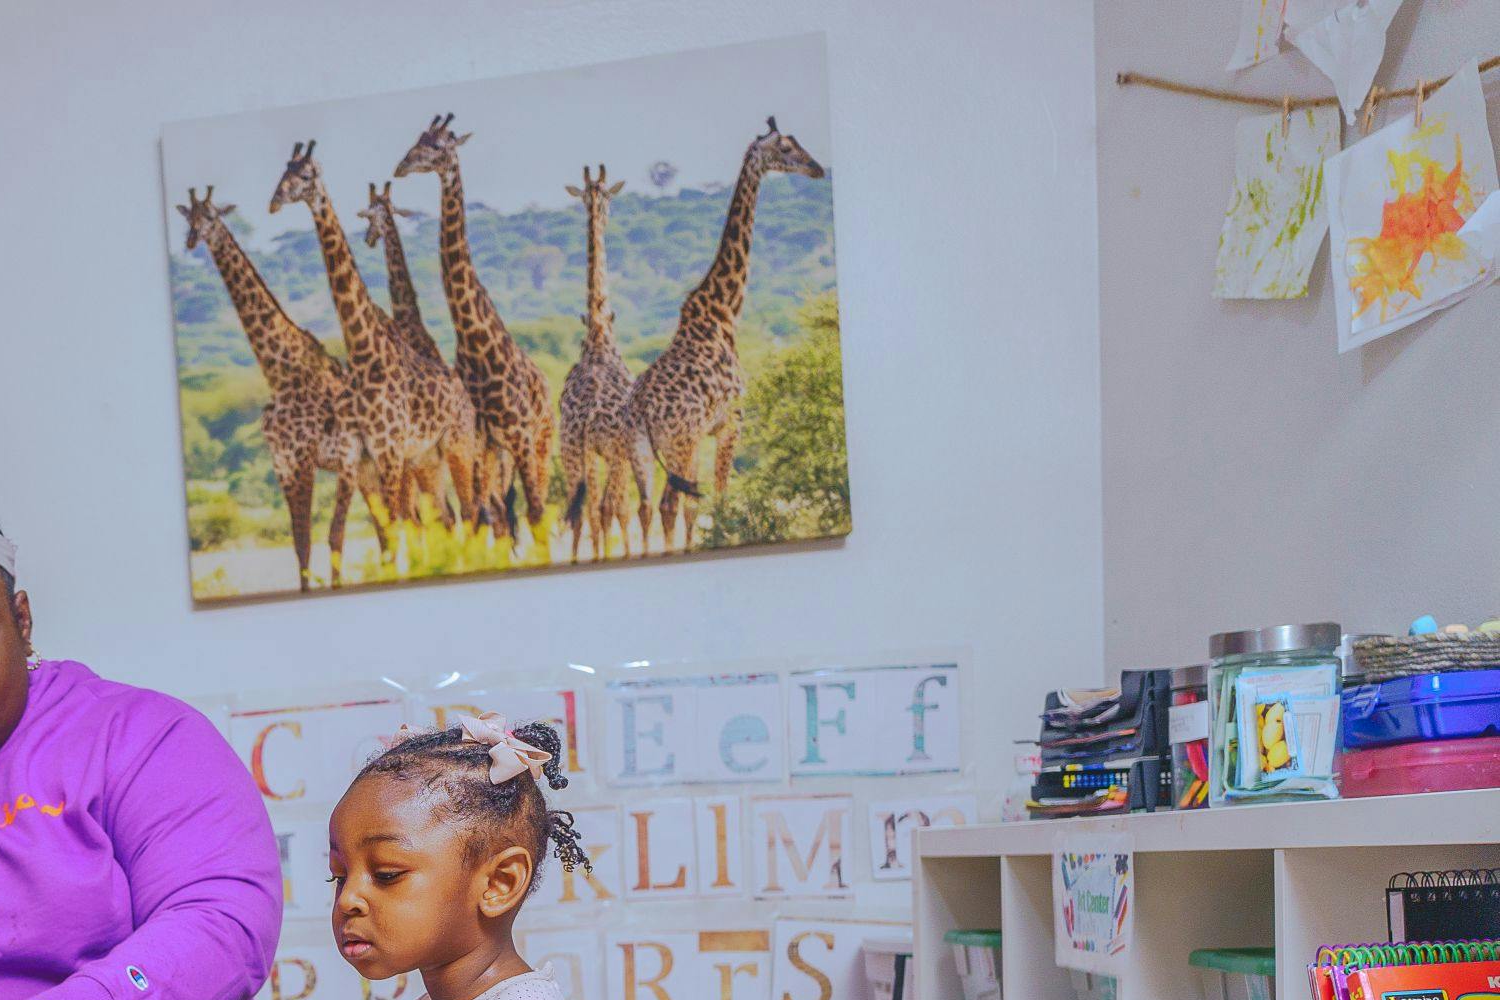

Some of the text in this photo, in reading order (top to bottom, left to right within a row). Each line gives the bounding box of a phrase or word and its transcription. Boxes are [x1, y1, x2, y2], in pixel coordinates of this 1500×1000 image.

[618, 694, 676, 778] E
[719, 713, 771, 774] e
[799, 680, 856, 765] F
[905, 675, 948, 763] f
[631, 812, 687, 891] L
[758, 810, 850, 892] M
